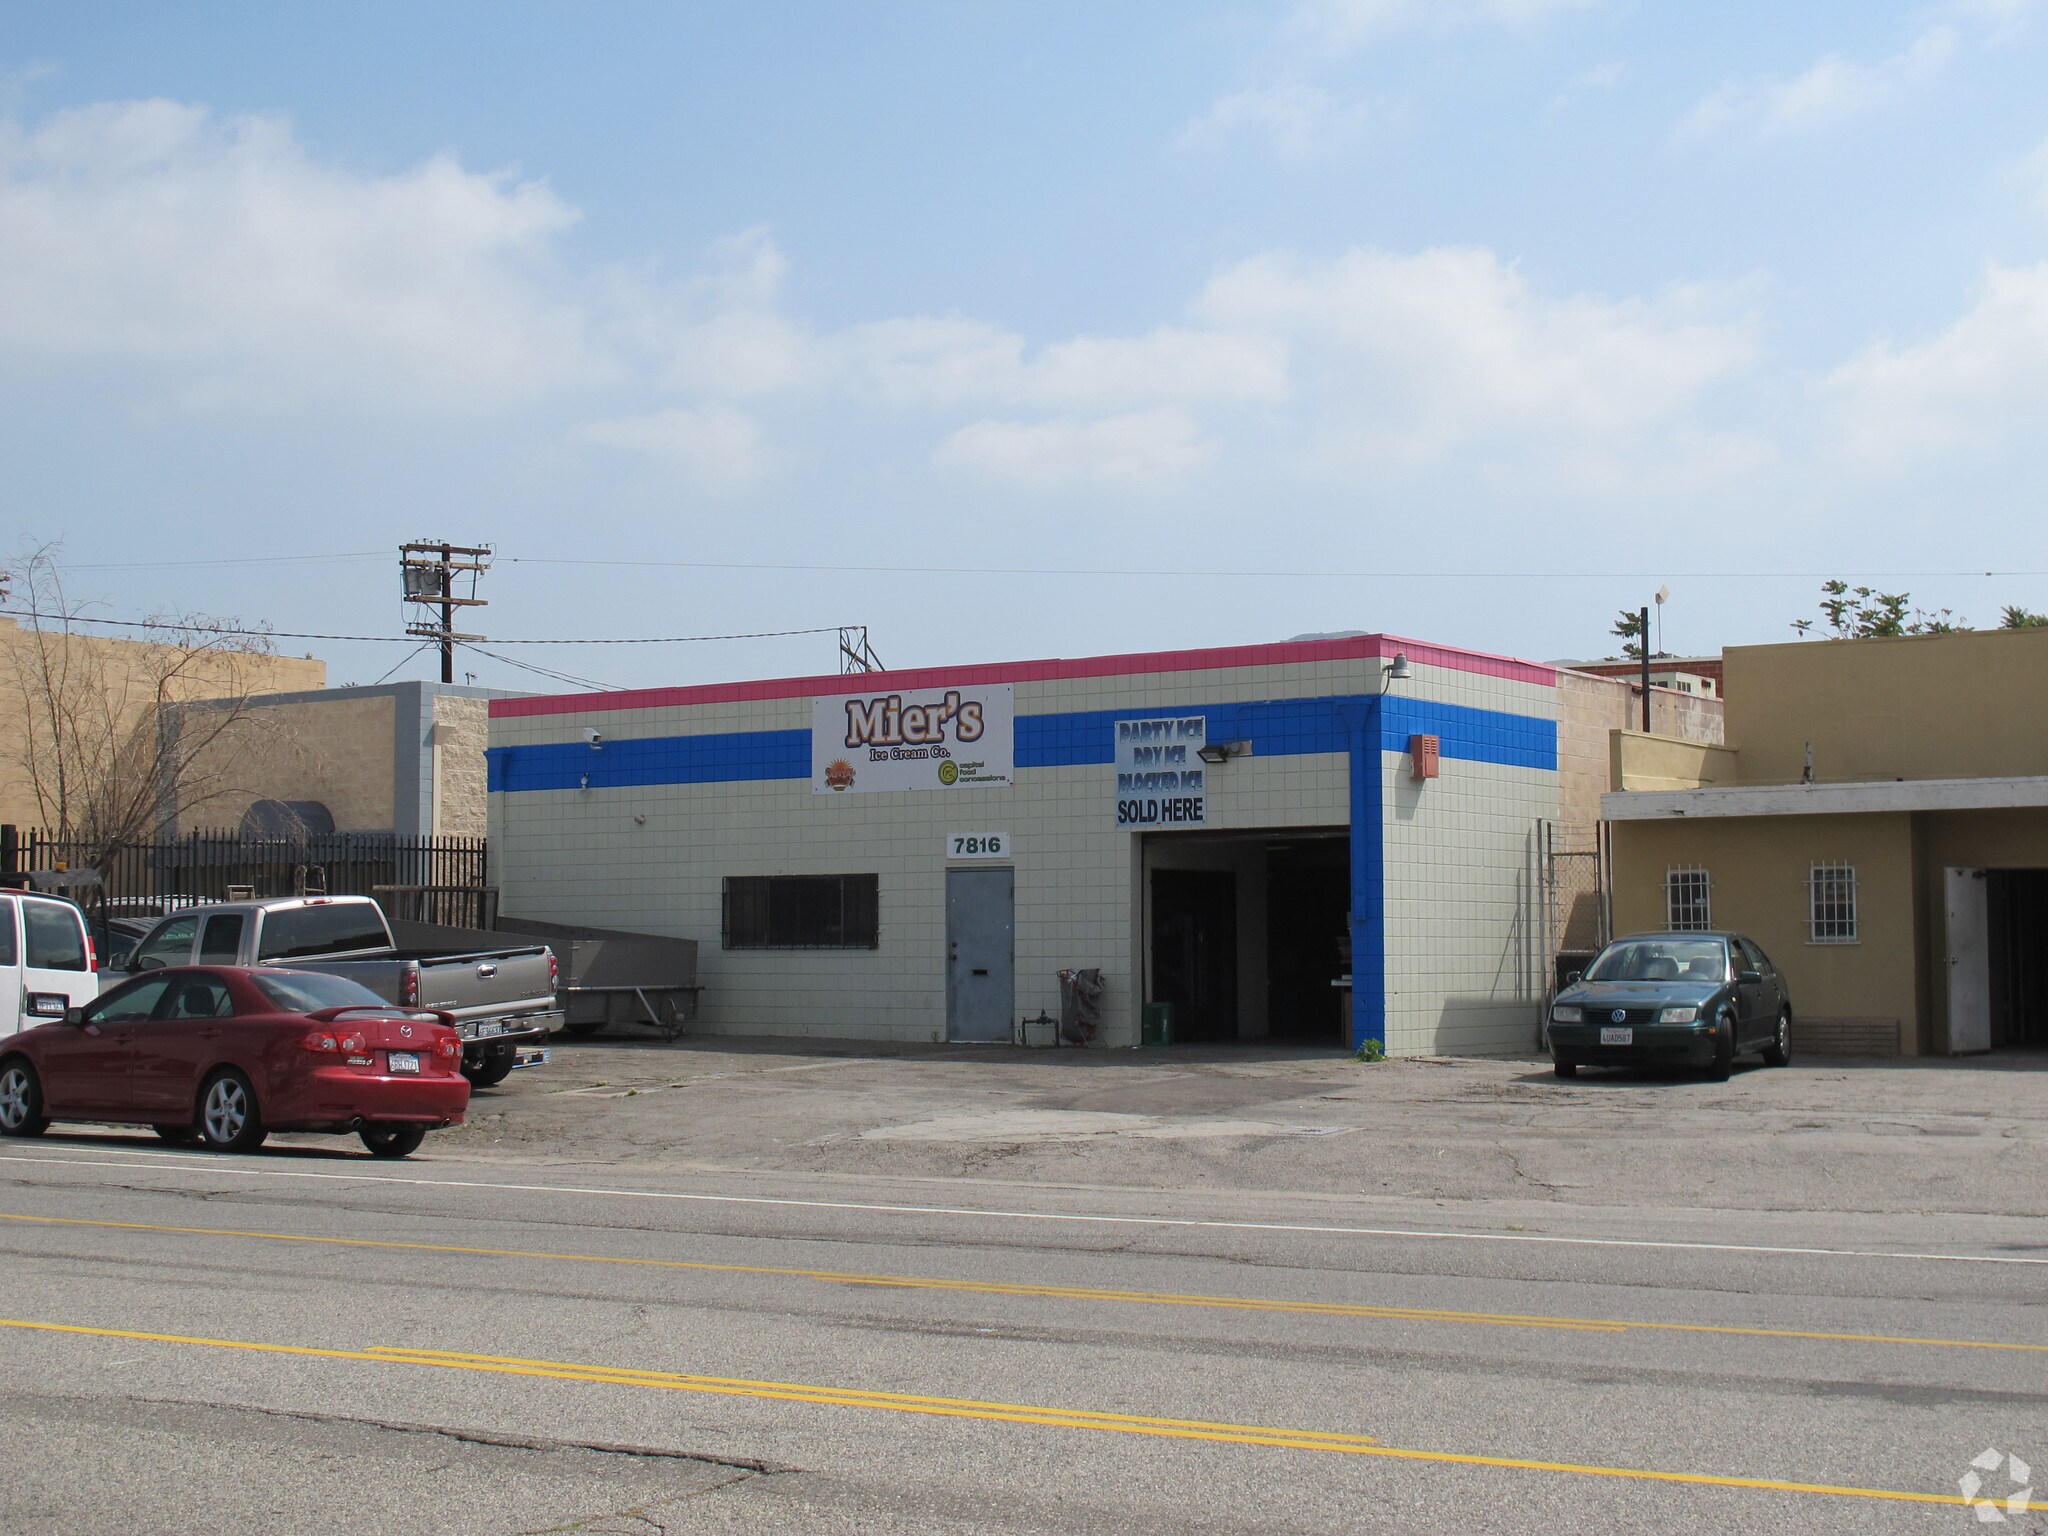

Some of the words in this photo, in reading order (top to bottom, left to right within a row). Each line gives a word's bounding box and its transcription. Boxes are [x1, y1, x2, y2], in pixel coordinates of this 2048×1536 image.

[845, 691, 985, 748] Mier's
[1119, 720, 1174, 744] PARTY
[1177, 719, 1203, 741] ICE
[869, 749, 888, 761] Ice
[890, 747, 928, 760] Cream
[930, 745, 951, 759] Co.
[1133, 746, 1163, 768] DRY
[1164, 745, 1186, 767] ICE
[1118, 771, 1179, 794] BLOCKED
[1180, 770, 1203, 792] ICE
[1118, 799, 1158, 823] SOLD
[1161, 797, 1203, 822] HERE
[954, 836, 1001, 854] 7816
